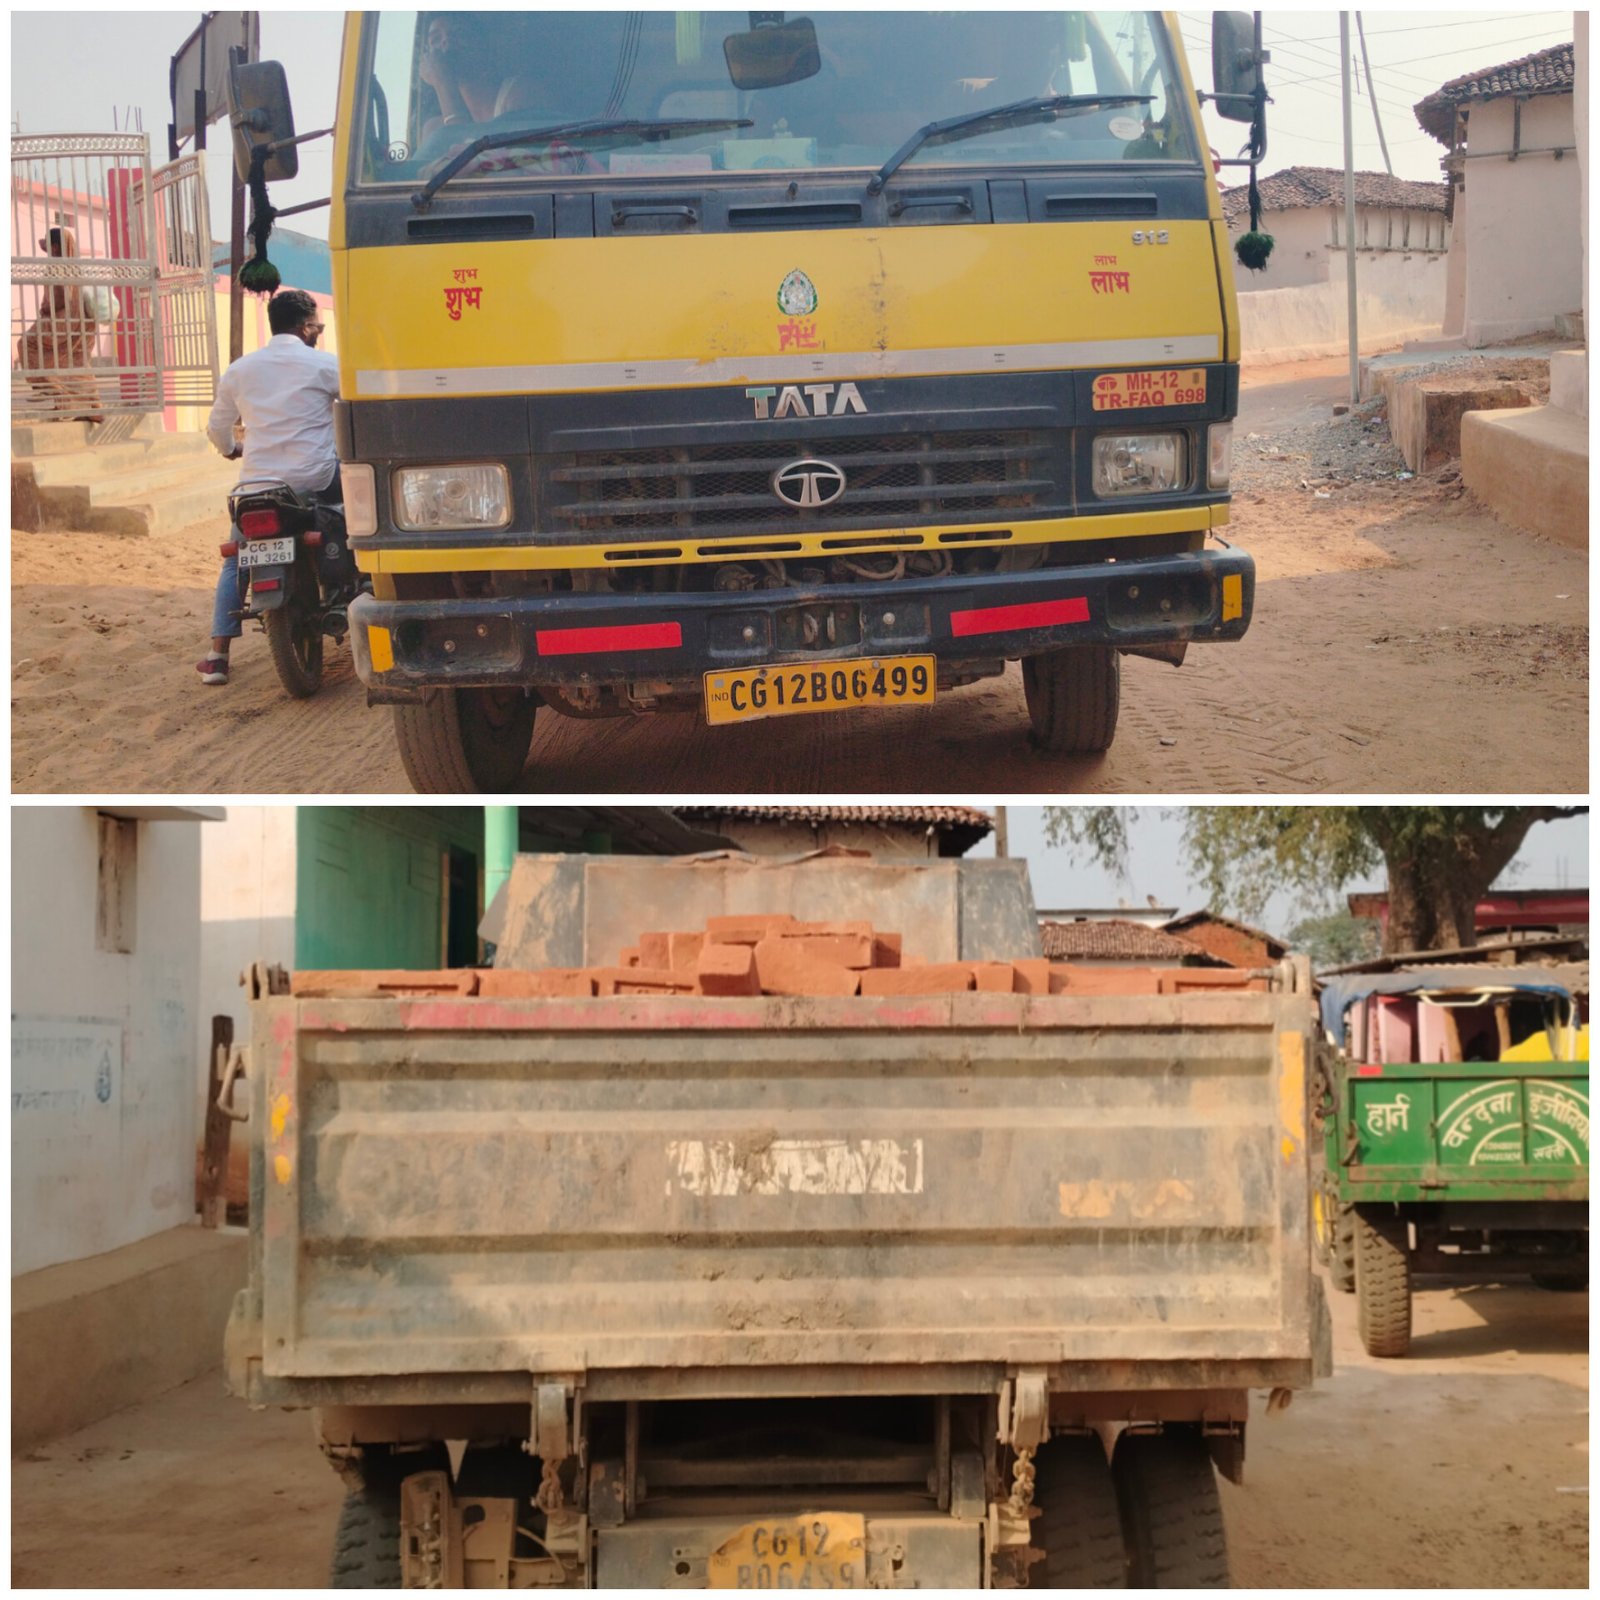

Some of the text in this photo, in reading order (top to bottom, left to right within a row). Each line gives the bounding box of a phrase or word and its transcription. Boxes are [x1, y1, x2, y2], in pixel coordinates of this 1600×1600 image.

[1132, 230, 1169, 246] 912
[1088, 271, 1130, 294] लाभ
[443, 286, 483, 321] शुभ
[1126, 371, 1178, 391] MH-12
[745, 382, 868, 420] TATA
[1096, 387, 1205, 409] TR-FAQ 698
[249, 541, 284, 553] CG 12
[240, 552, 291, 565] BN 3261
[731, 665, 928, 712] CG12BQ6499
[1365, 1093, 1411, 1137] हार्न
